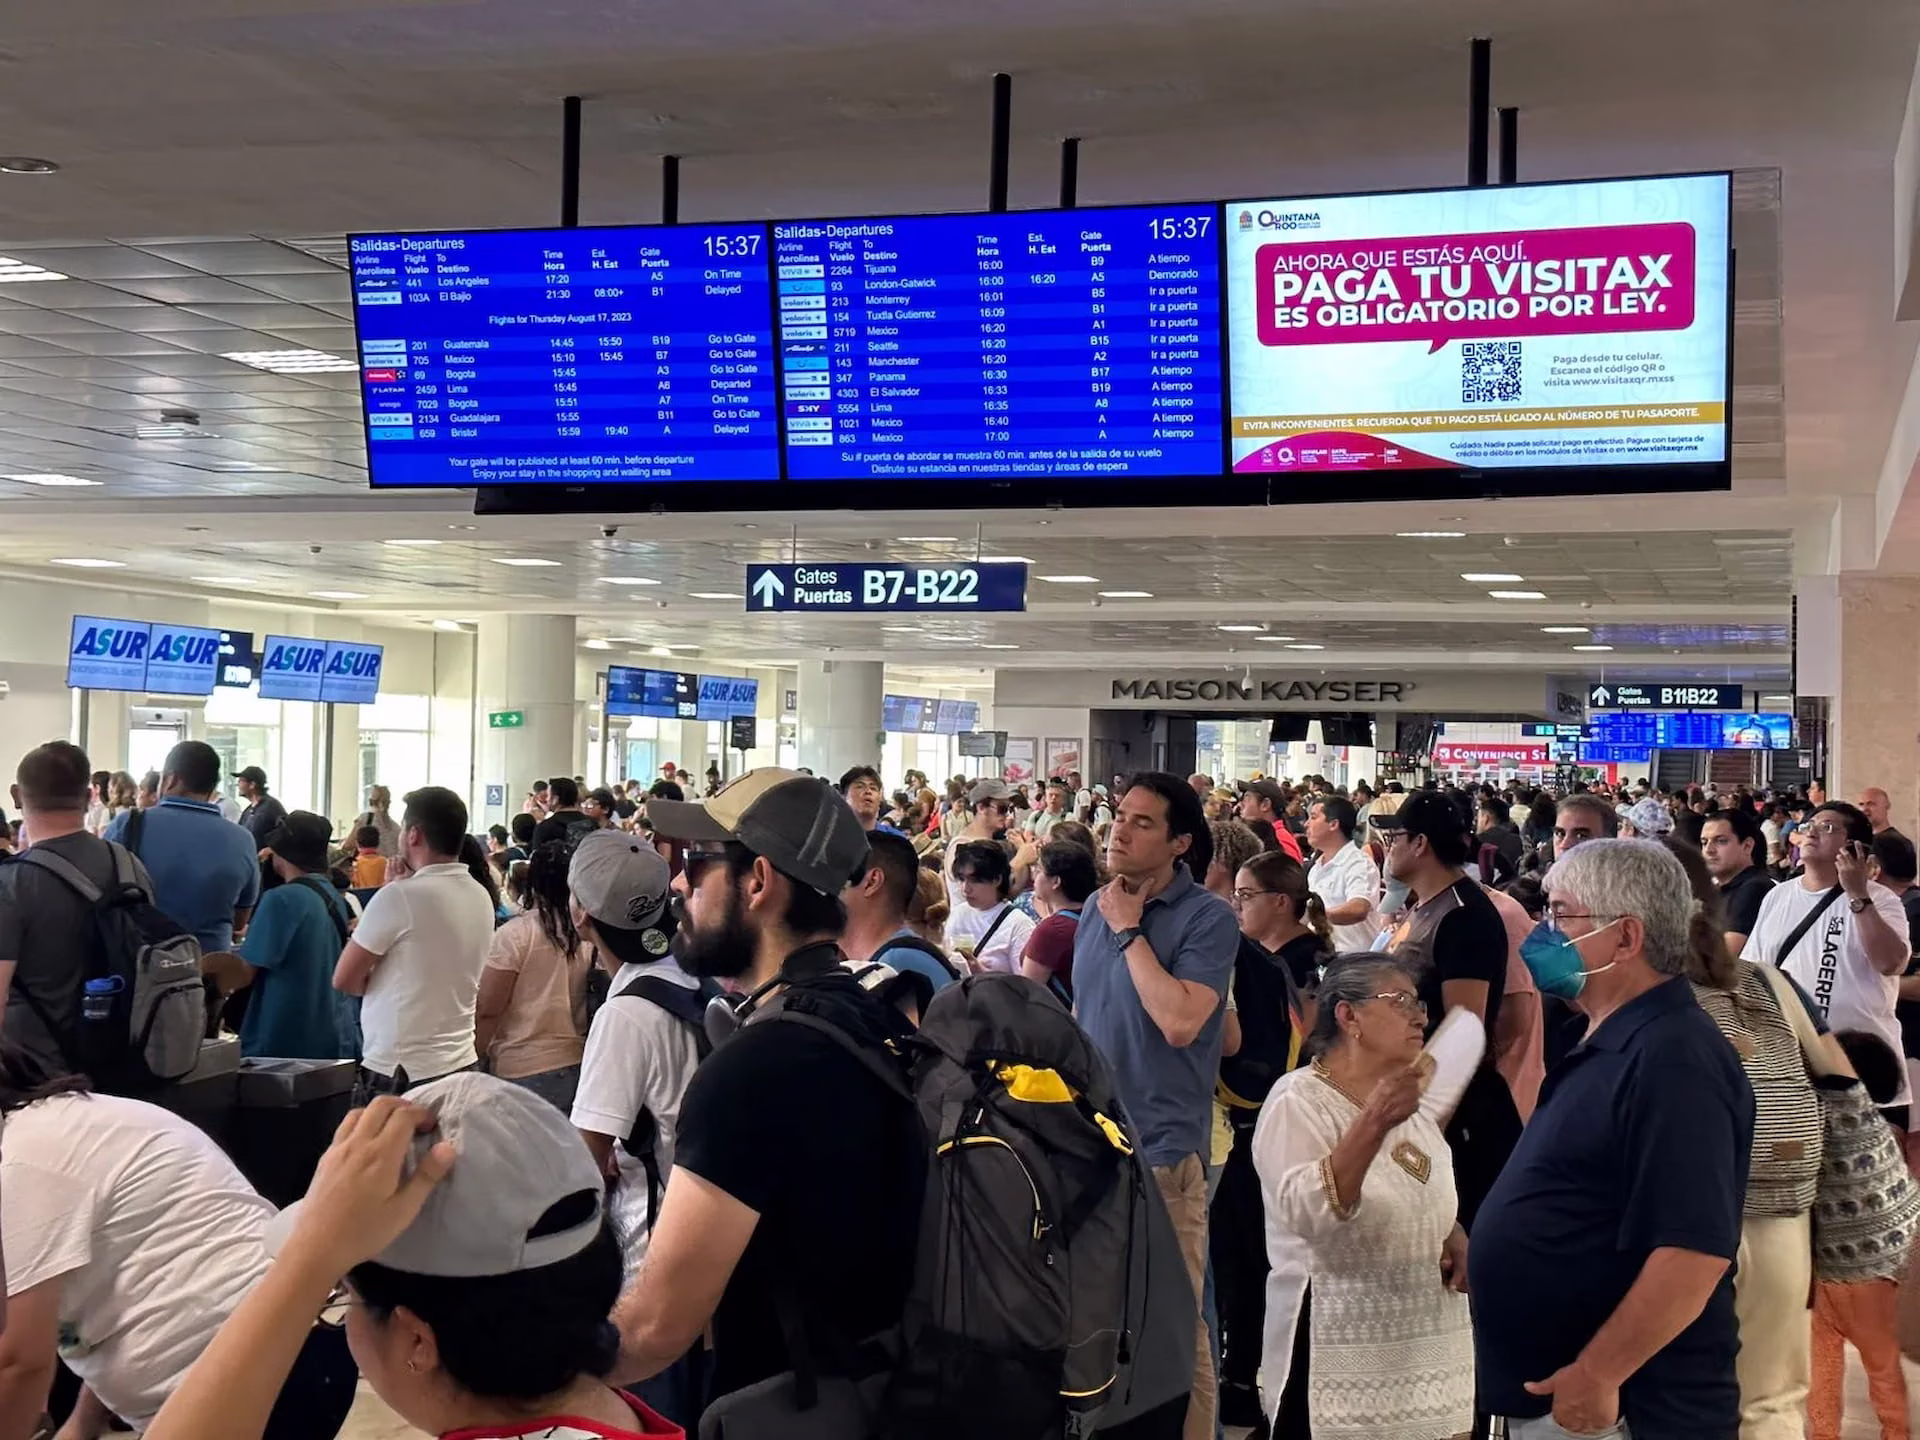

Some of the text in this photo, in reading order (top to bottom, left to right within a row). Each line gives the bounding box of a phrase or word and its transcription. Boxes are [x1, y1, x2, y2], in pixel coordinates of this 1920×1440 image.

[1258, 210, 1320, 227] QUINTANA
[1275, 222, 1296, 230] ROO
[775, 217, 1211, 239] Salidas-Departures 15:37
[352, 235, 760, 256] Salidas-Departures 15:37
[830, 243, 1111, 261] Vuelo Destino Hora Puerta
[404, 248, 660, 263] Flight To Time Gate
[864, 264, 896, 274] Tijuana
[978, 261, 1003, 270] 16:00
[1149, 255, 1156, 263] A
[1158, 254, 1190, 264] tiempo
[1274, 240, 1527, 272] AHORA QUE ESTÁS AQUÍ.
[405, 259, 669, 274] Vuelo Destino Hora Puerta
[406, 279, 422, 287] 441
[438, 277, 454, 286] Los
[455, 277, 489, 287] Angeles
[546, 275, 569, 284] 17:20
[651, 272, 663, 280] A5
[720, 270, 741, 278] Time
[831, 282, 843, 291] 93
[865, 279, 936, 289] London-Gatwick
[979, 277, 1004, 286] 16:00
[1030, 275, 1055, 284] 16:20
[1092, 272, 1104, 281] A5
[1149, 270, 1198, 280] Demorado
[1275, 254, 1672, 304] PAGA TU VISITAX
[832, 298, 849, 306] 213
[866, 296, 910, 305] Monterrey
[979, 292, 1003, 301] 16:01
[1150, 287, 1156, 295] Ir
[1167, 286, 1197, 296] puerta
[1275, 291, 1666, 328] ES OBLIGATORIO POR LEY.
[489, 315, 515, 325] Flights
[517, 315, 527, 324] for
[529, 314, 565, 324] Thursday
[568, 314, 595, 324] August
[612, 313, 632, 322] 2023
[834, 328, 856, 336] 5719
[981, 324, 1005, 333] 16:20
[1093, 320, 1105, 329] A1
[1150, 319, 1157, 327] Ir
[1168, 318, 1198, 329] puerta
[412, 341, 427, 350] 201
[444, 340, 489, 349] Guatemala
[551, 338, 574, 347] 14:45
[599, 337, 622, 346] 15:50
[652, 336, 670, 345] B19
[708, 335, 721, 343] Go
[723, 335, 732, 343] to
[734, 334, 756, 343] Gate
[414, 349, 757, 364] 705 Mexico 15:10 15:45 B7 Go to Gate
[836, 359, 852, 367] 143
[868, 357, 920, 366] Manchester
[982, 355, 1006, 364] 16:20
[1094, 352, 1106, 361] A2
[1152, 351, 1158, 359] Ir
[1169, 349, 1198, 360] puerta
[1553, 355, 1577, 365] Paga
[1580, 354, 1609, 363] desde
[1626, 352, 1662, 361] celular.
[836, 374, 852, 382] 347
[870, 373, 906, 381] Panama
[983, 370, 1007, 379] 16:30
[1092, 368, 1109, 377] B17
[1152, 366, 1159, 375] A
[1161, 366, 1192, 376] tiempo
[1551, 366, 1591, 375] Escanea
[1594, 365, 1602, 373] el
[1605, 365, 1638, 375] código
[1641, 364, 1656, 372] QR
[448, 385, 468, 394] Lima
[554, 383, 577, 392] 15:45
[711, 379, 751, 390] Departed
[1544, 378, 1570, 387] visita
[1243, 422, 1269, 430] EVITA
[1357, 416, 1409, 427] RECUERDA
[1412, 416, 1432, 426] QUE
[1434, 416, 1447, 424] TU
[1449, 414, 1477, 423] PAGO
[1479, 412, 1503, 423] ESTÁ
[1505, 412, 1541, 422] LIGADO
[1543, 412, 1555, 421] AL
[1558, 409, 1602, 420] NÚMERO
[1605, 410, 1619, 419] DE
[1622, 410, 1635, 418] TU
[1637, 408, 1700, 418] PASAPORTE.
[451, 428, 477, 437] Bristol
[605, 426, 628, 435] 19:40
[664, 426, 670, 434] A
[714, 424, 749, 434] Delayed
[794, 568, 979, 604] Gates B7-B22
[794, 588, 852, 603] Puertas
[74, 627, 149, 659] ASUR
[150, 634, 221, 665] ASUR
[264, 645, 324, 673] ASUR
[326, 650, 381, 677] ASUR
[700, 682, 757, 701] ASUR ASUR
[1112, 680, 1402, 702] MAISON KAYSER
[1617, 687, 1642, 695] Gates
[1814, 930, 1842, 1019] LAGERF
